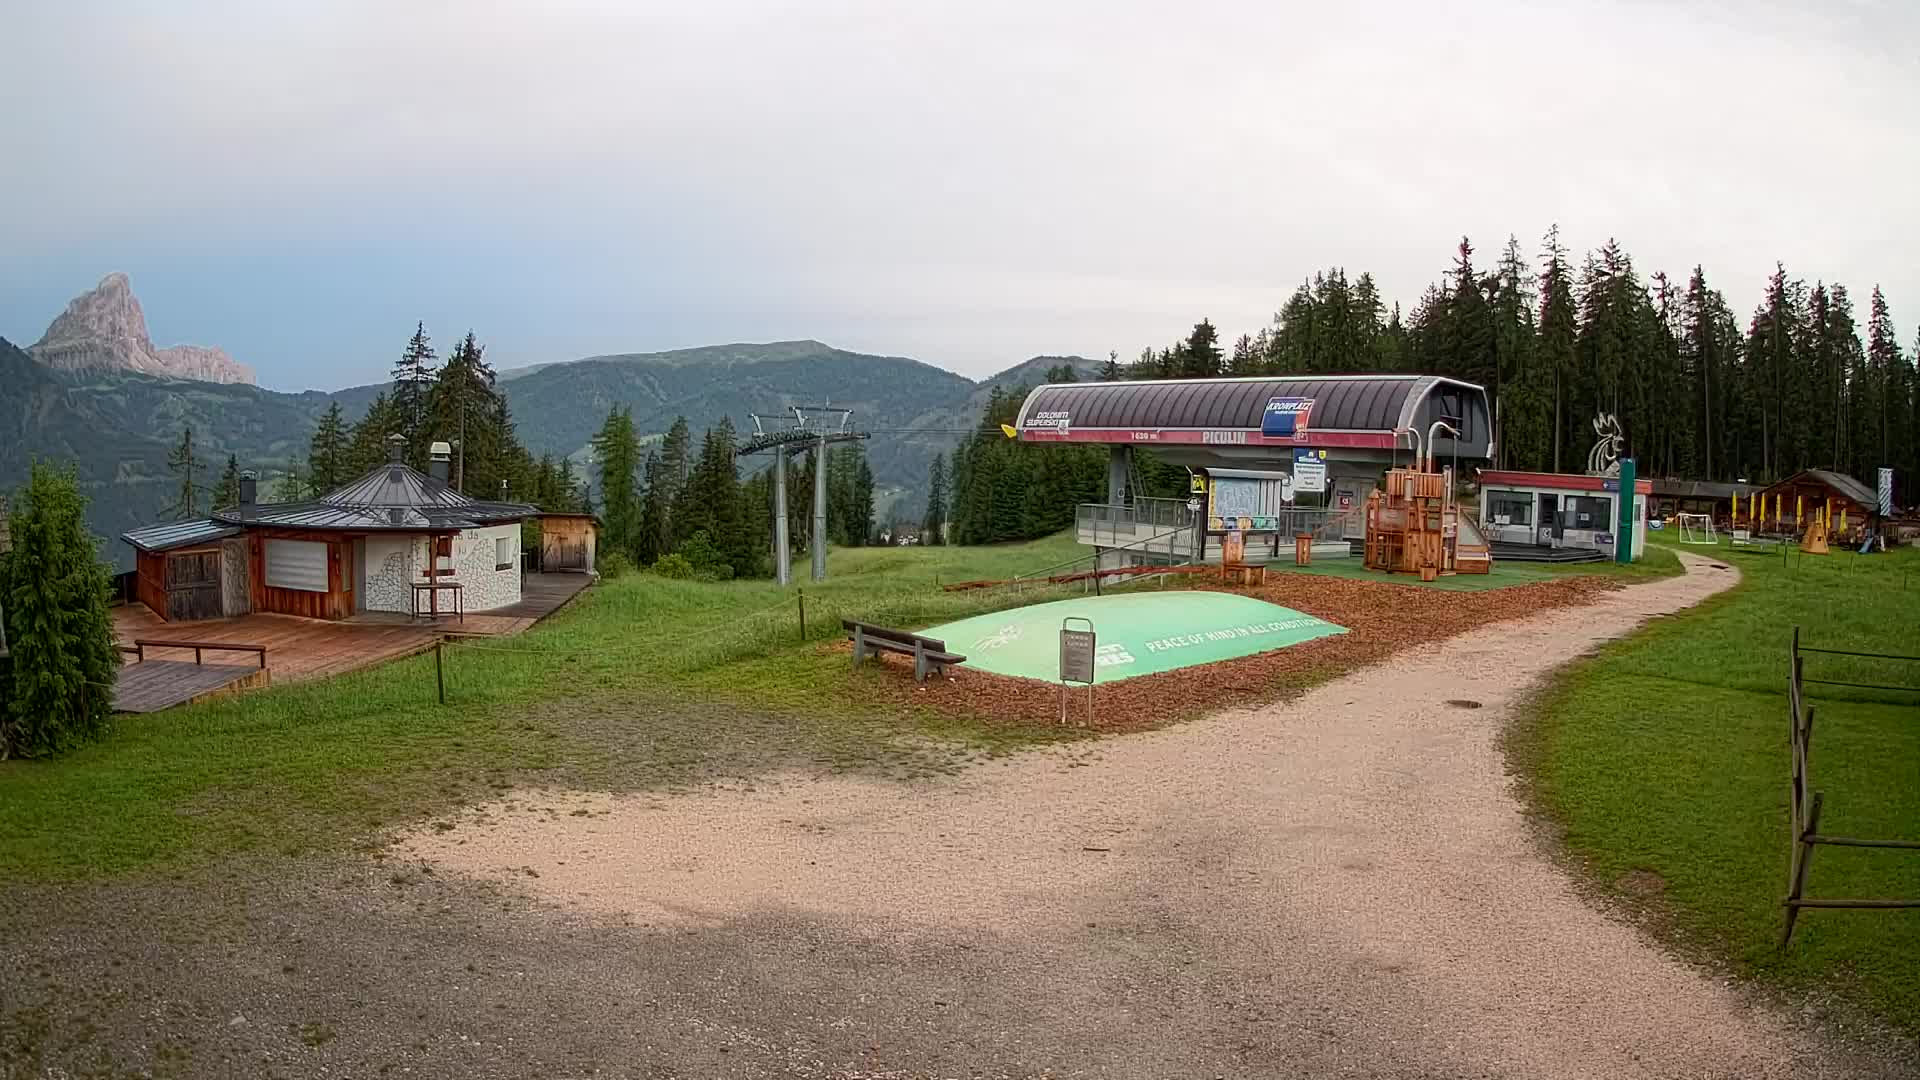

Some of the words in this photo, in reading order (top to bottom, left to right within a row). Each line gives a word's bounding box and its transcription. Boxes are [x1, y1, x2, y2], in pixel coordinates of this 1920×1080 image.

[1266, 402, 1312, 411] KRONPLATZ
[1202, 431, 1246, 444] PICULIN
[1145, 635, 1189, 652] PEACE
[1188, 632, 1205, 644] OF
[1207, 628, 1236, 641] MIND
[1249, 621, 1270, 634] ALL
